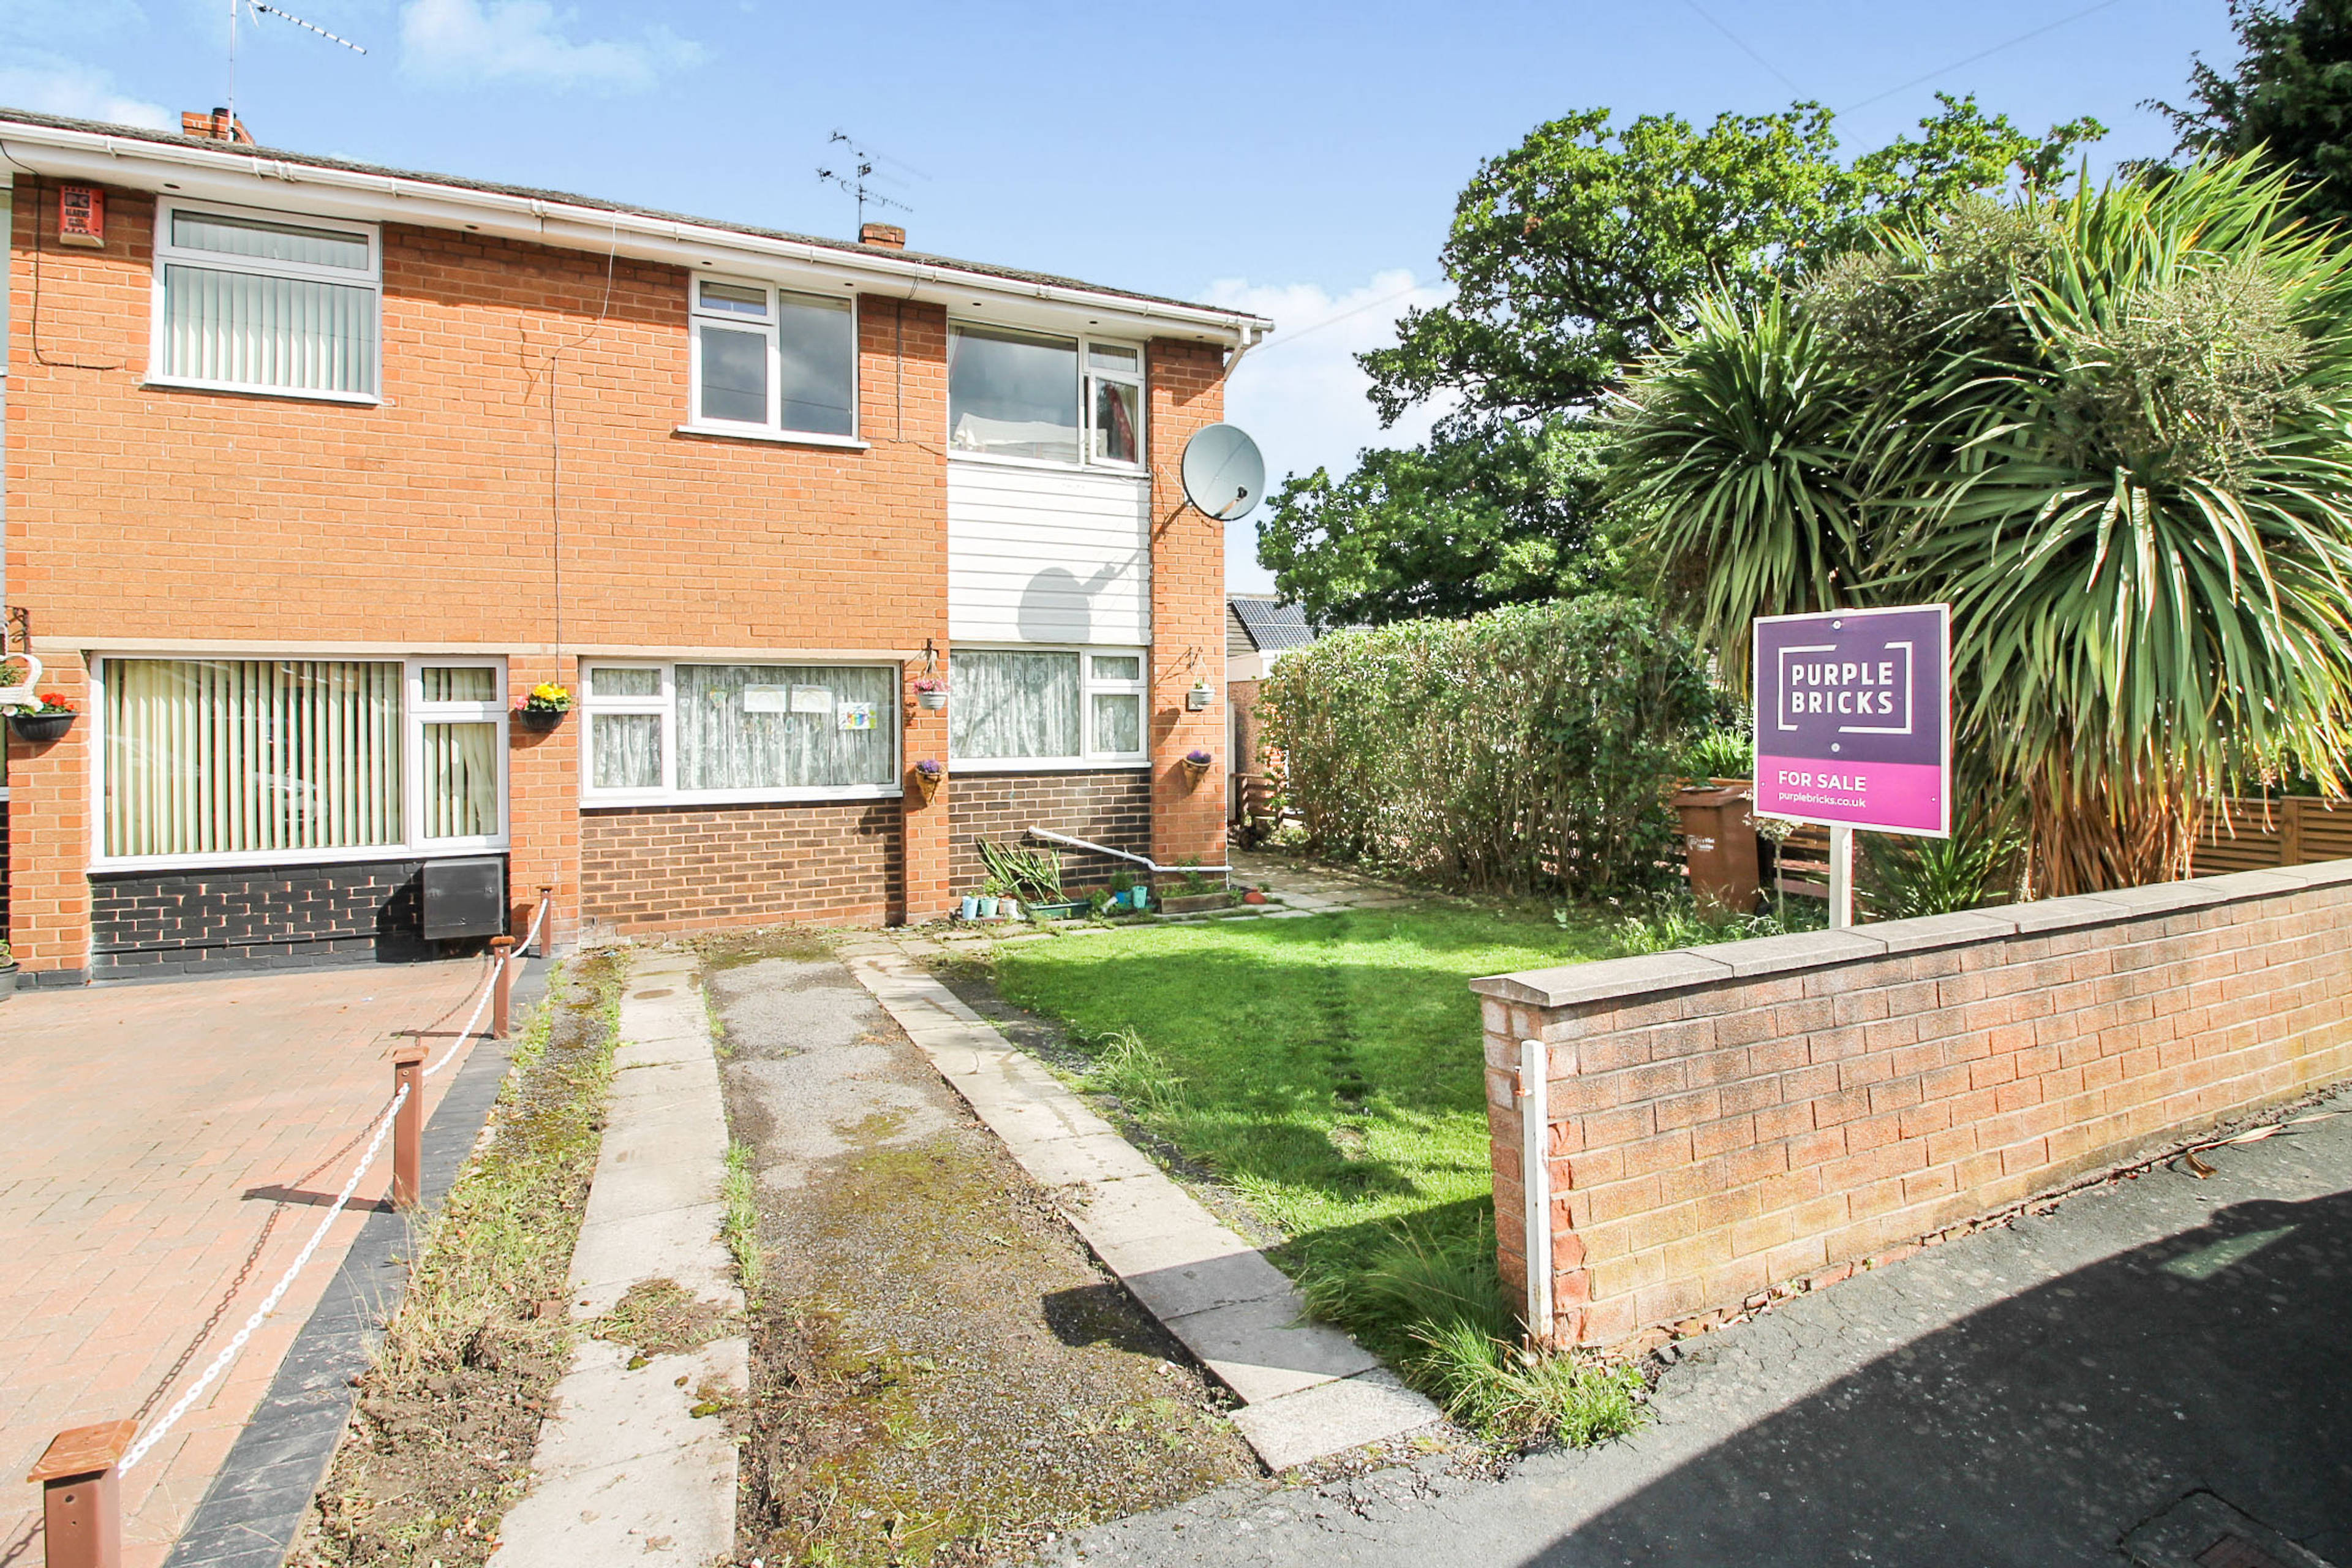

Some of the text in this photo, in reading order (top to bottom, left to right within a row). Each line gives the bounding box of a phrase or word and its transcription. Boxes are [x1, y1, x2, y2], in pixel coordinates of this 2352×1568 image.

[1792, 662, 1893, 686] PURPLE
[1792, 691, 1893, 714] BRICKS
[1778, 770, 1867, 792] FOR SALE
[1778, 792, 1866, 808] purplebricks.co.uk
